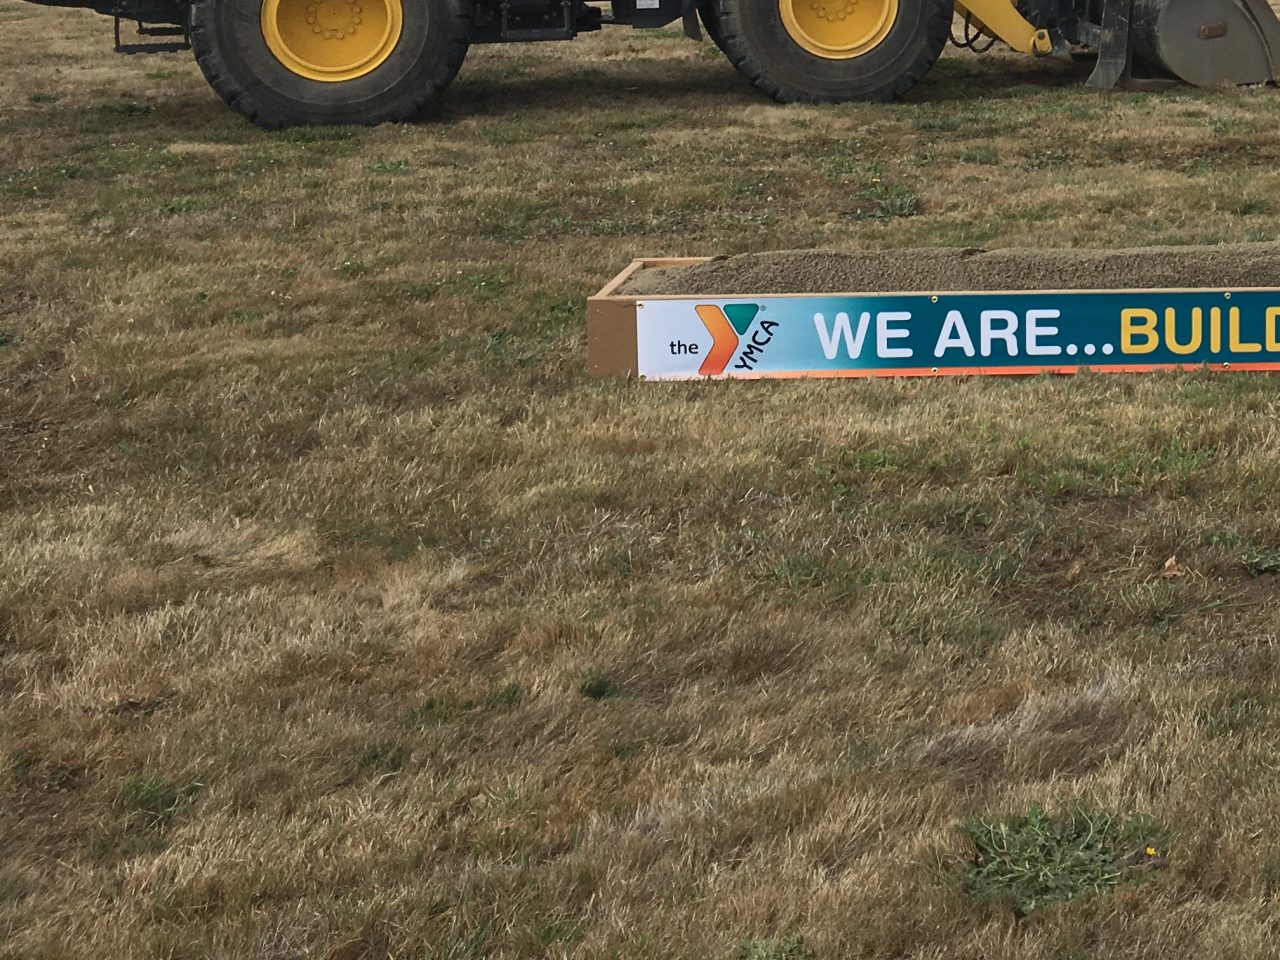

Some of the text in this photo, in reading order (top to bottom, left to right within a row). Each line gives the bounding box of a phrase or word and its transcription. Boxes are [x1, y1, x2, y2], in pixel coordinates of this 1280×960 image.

[669, 340, 699, 355] the
[735, 320, 779, 371] YMCA
[813, 311, 914, 360] WE
